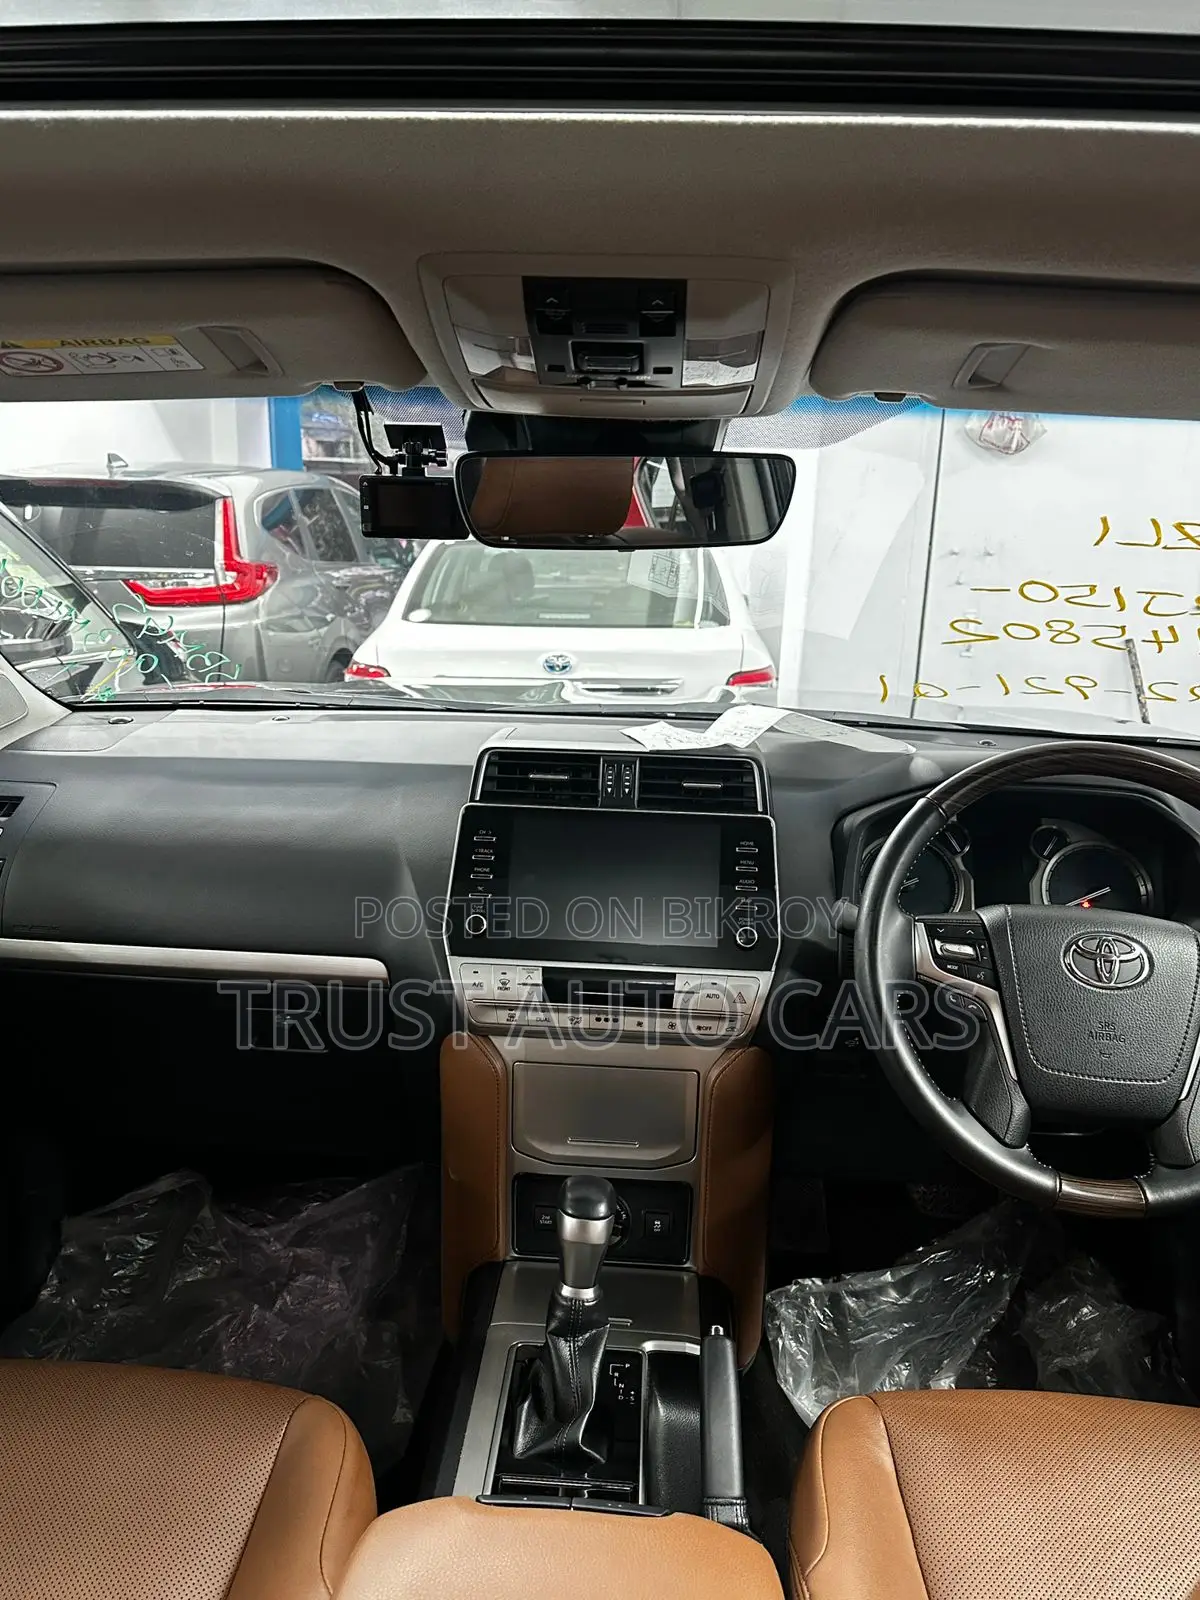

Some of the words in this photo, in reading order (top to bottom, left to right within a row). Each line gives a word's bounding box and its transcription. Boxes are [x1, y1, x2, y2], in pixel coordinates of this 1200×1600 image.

[60, 336, 151, 347] AIRBAG
[1098, 1021, 1116, 1031] SRS
[1088, 1031, 1126, 1043] AIRBAG
